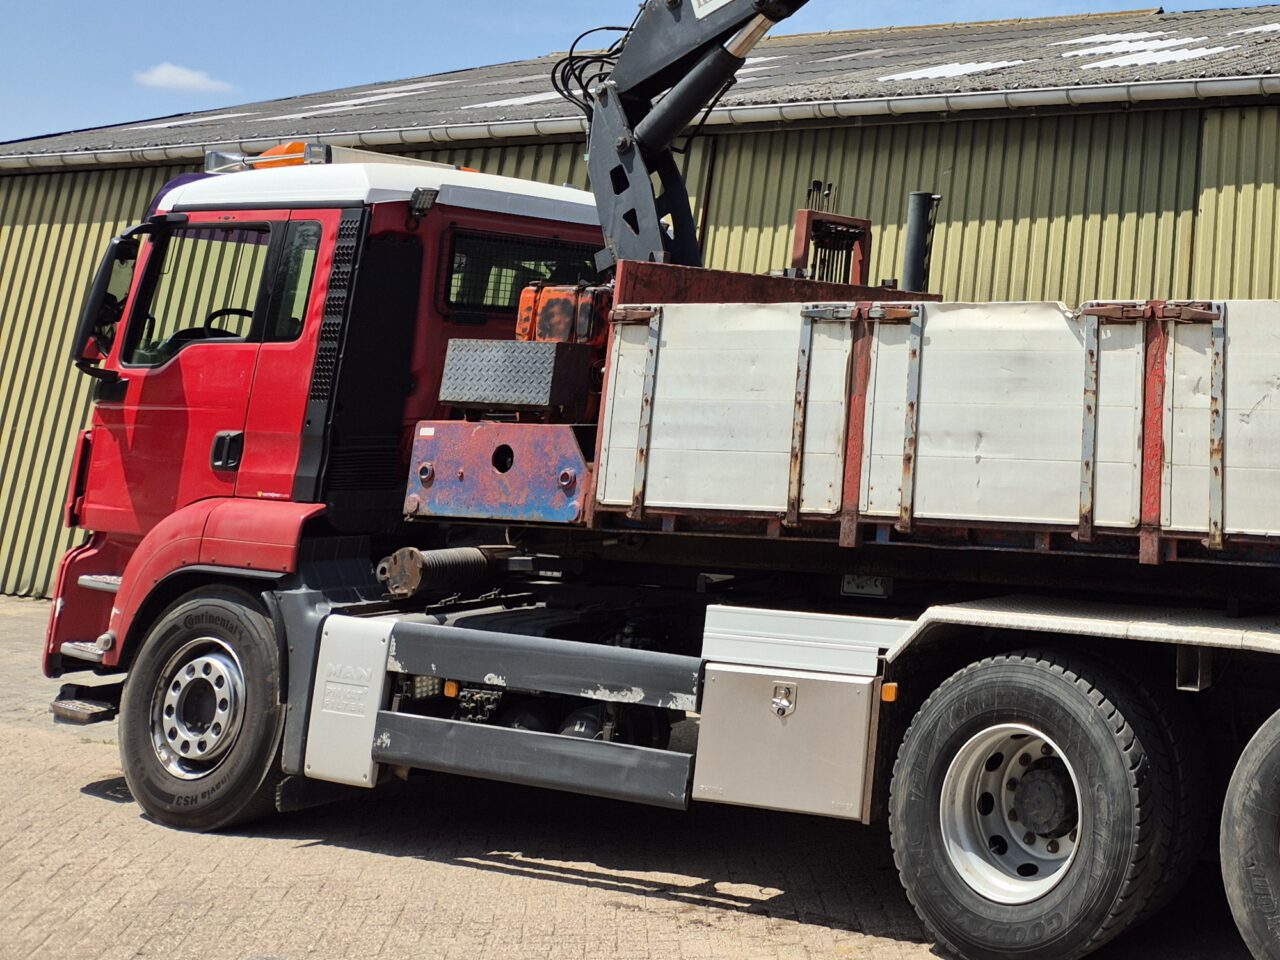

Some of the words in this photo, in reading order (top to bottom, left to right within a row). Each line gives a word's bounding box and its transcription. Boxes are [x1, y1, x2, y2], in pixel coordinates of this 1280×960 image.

[183, 611, 239, 636] Continental
[326, 662, 372, 682] MAN
[175, 794, 198, 807] HS3
